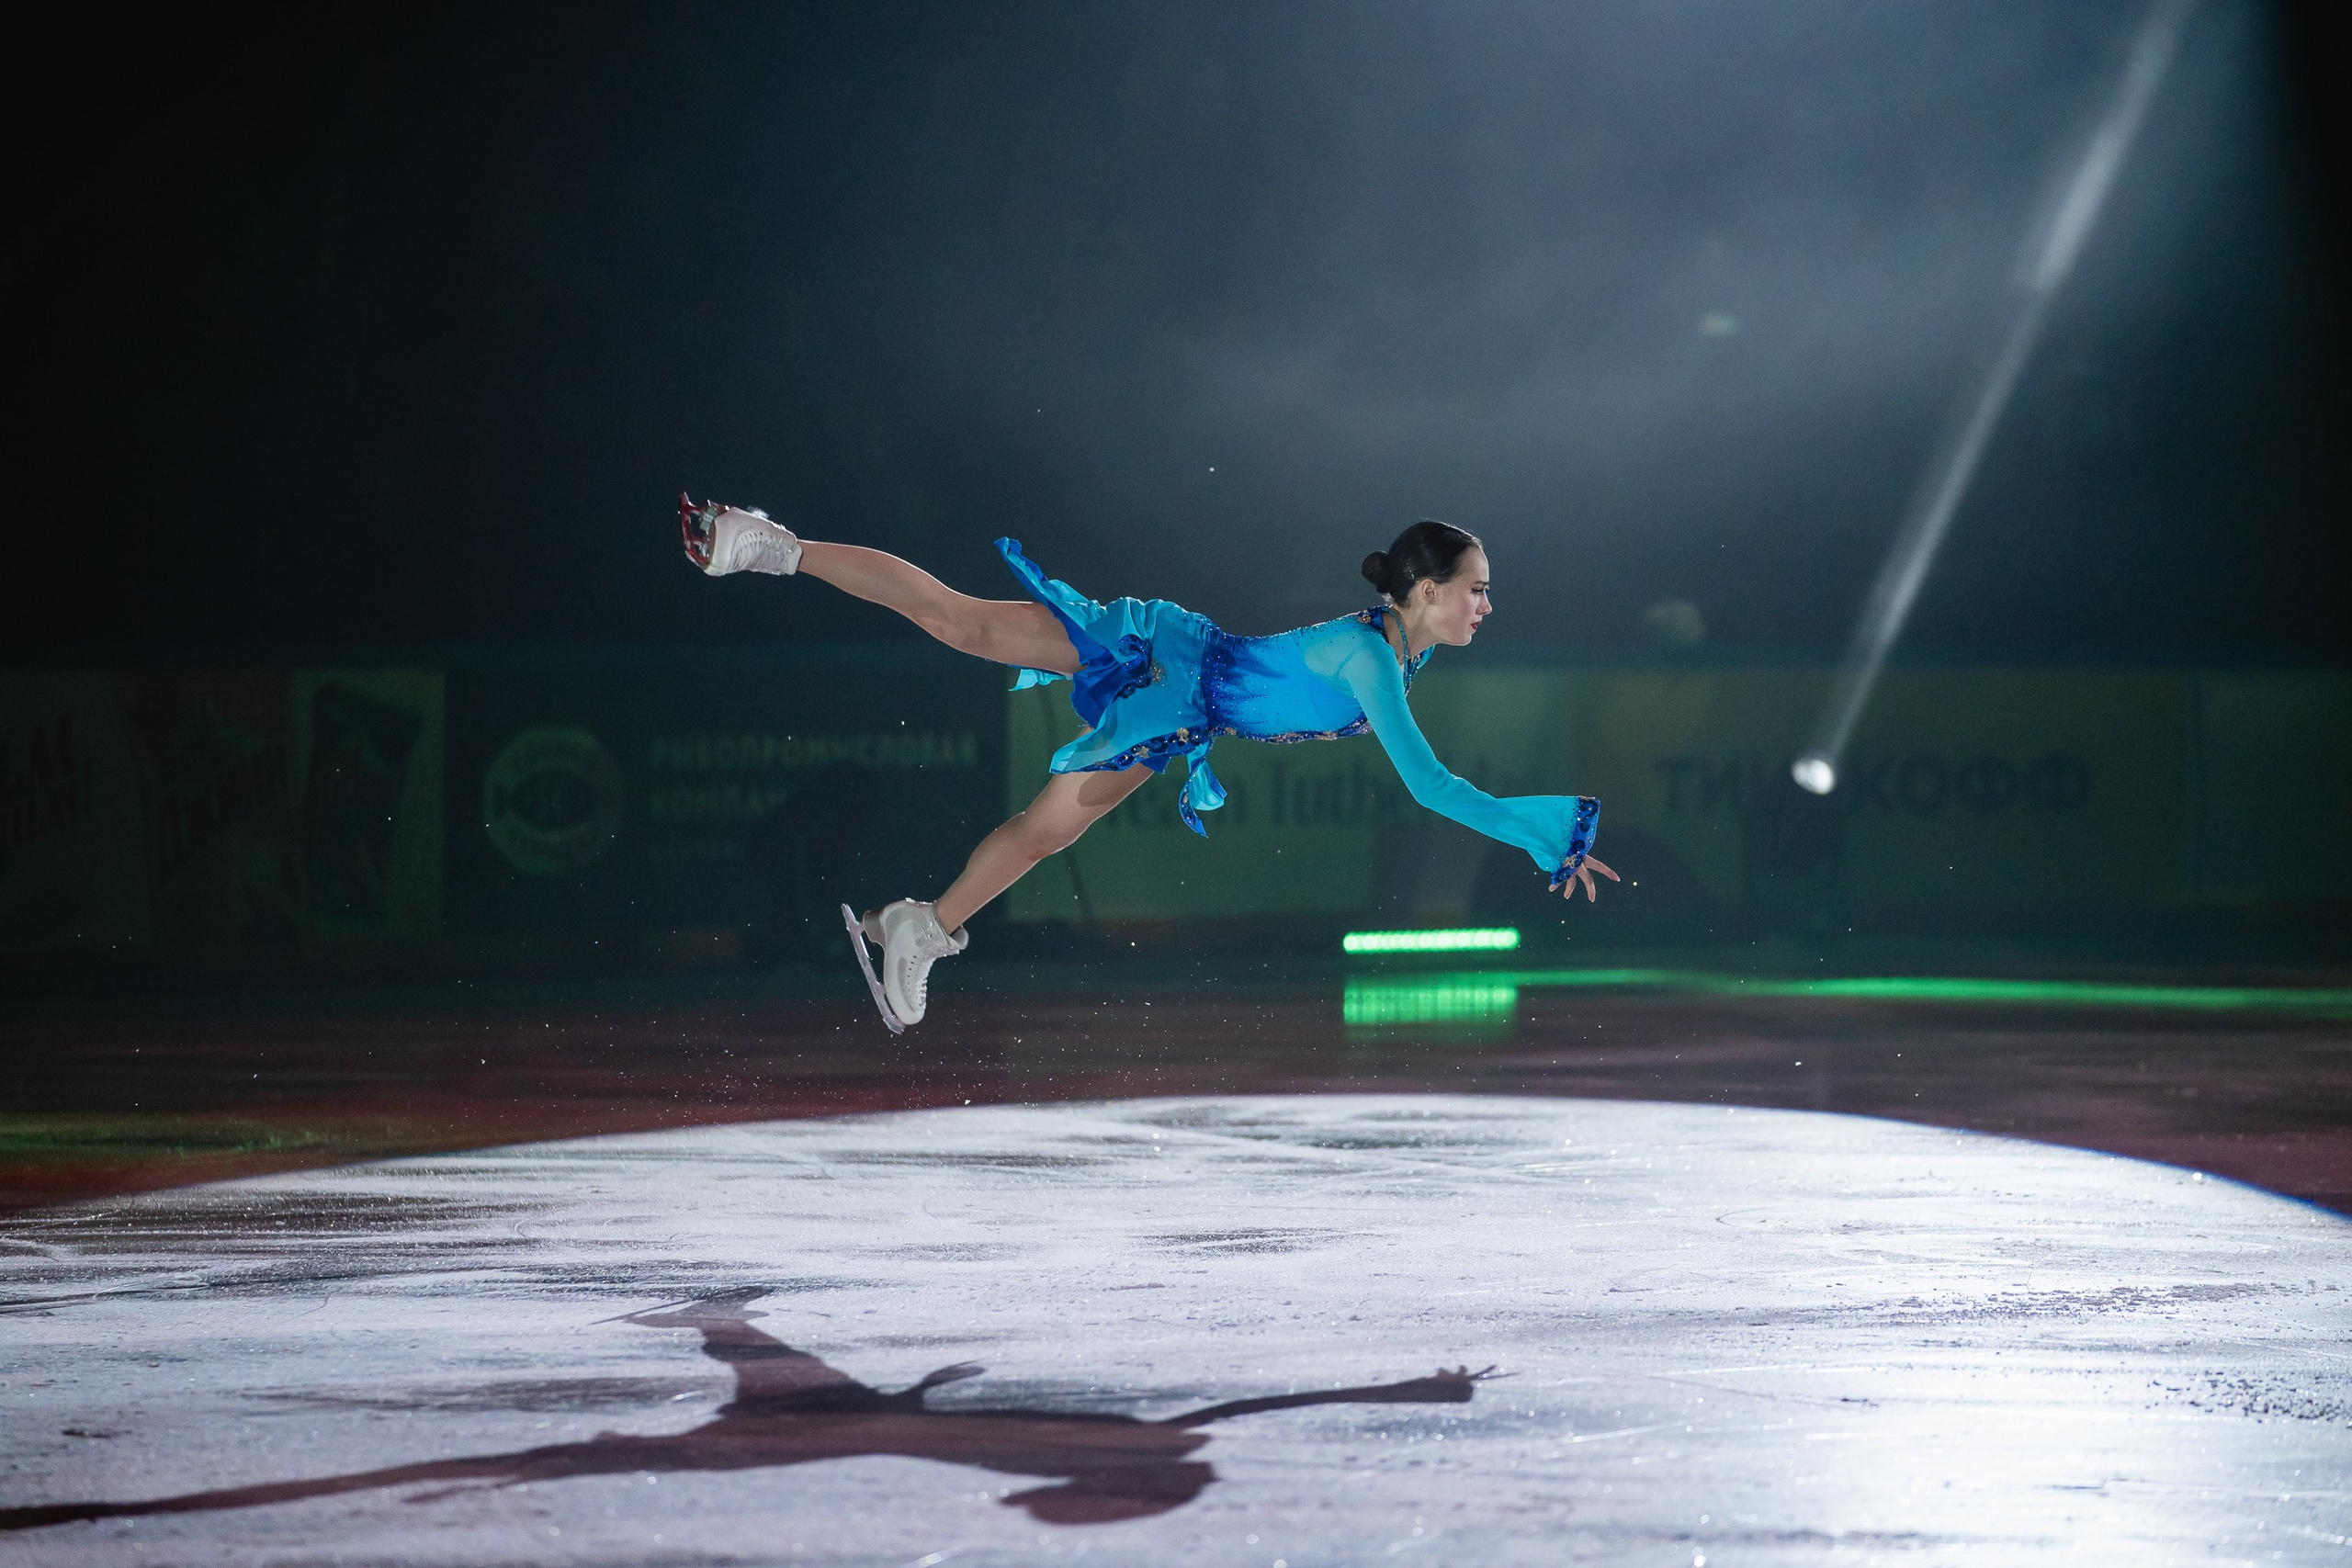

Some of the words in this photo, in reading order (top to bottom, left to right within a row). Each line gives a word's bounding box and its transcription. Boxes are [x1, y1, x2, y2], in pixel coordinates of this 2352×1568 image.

[650, 783, 788, 818] КОМПА
[1106, 773, 1248, 829] ea
[1652, 752, 2094, 818] ТИКОФФ
